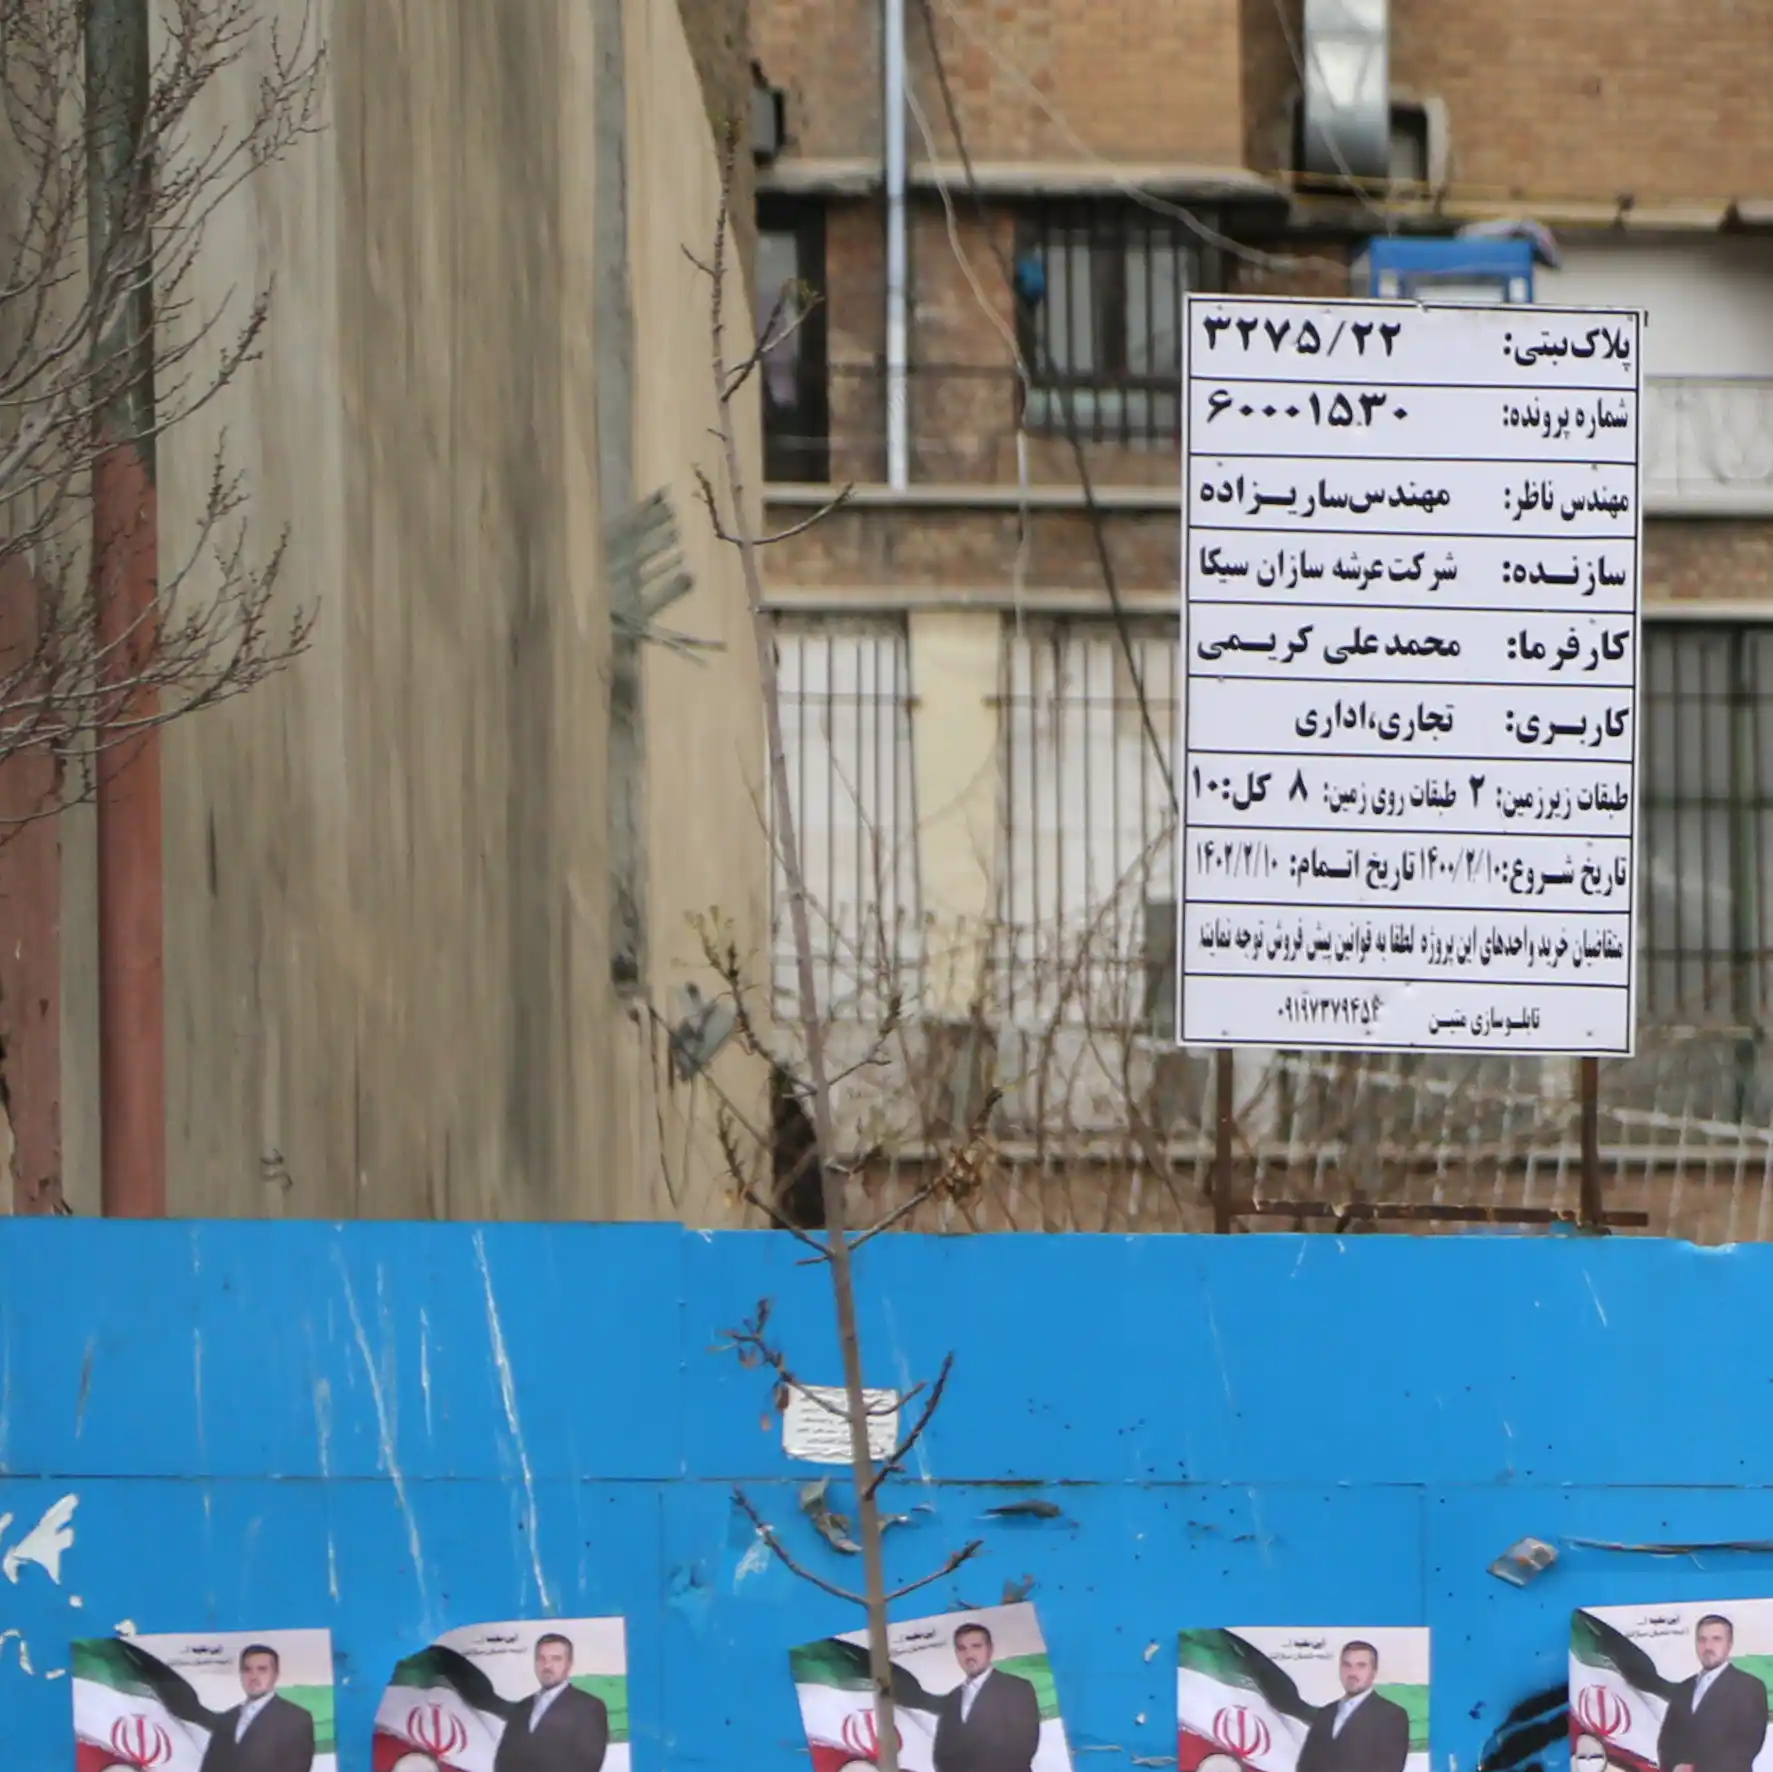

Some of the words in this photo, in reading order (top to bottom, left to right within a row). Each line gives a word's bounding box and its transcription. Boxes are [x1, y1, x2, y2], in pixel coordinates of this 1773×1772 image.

[1202, 316, 1402, 357] ۳۲۷۵/۲۲
[1570, 327, 1631, 372] پلاک
[1575, 398, 1628, 439] شماره
[1348, 481, 1451, 514] مهندس
[1504, 480, 1554, 522] ناظر:
[1559, 482, 1629, 519] مهندس
[1256, 549, 1324, 589] سازان
[1332, 554, 1383, 591] عرشه
[1388, 552, 1458, 592] شرکت
[1502, 556, 1626, 597] سازنده:
[1197, 625, 1314, 664] کریمی
[1507, 627, 1630, 672] کارفرما:
[1505, 707, 1630, 748] کاربری:
[1288, 769, 1309, 801] ۸
[1323, 782, 1367, 815] زمین:
[1371, 787, 1405, 817] روی
[1410, 779, 1456, 818] طبقات
[1468, 775, 1486, 807] ۲
[1576, 778, 1628, 819] طبقات
[1290, 848, 1360, 885] اتمام:
[1365, 851, 1415, 892] تاریخ
[1580, 857, 1627, 897] تاریخ
[1539, 928, 1568, 968] خرید
